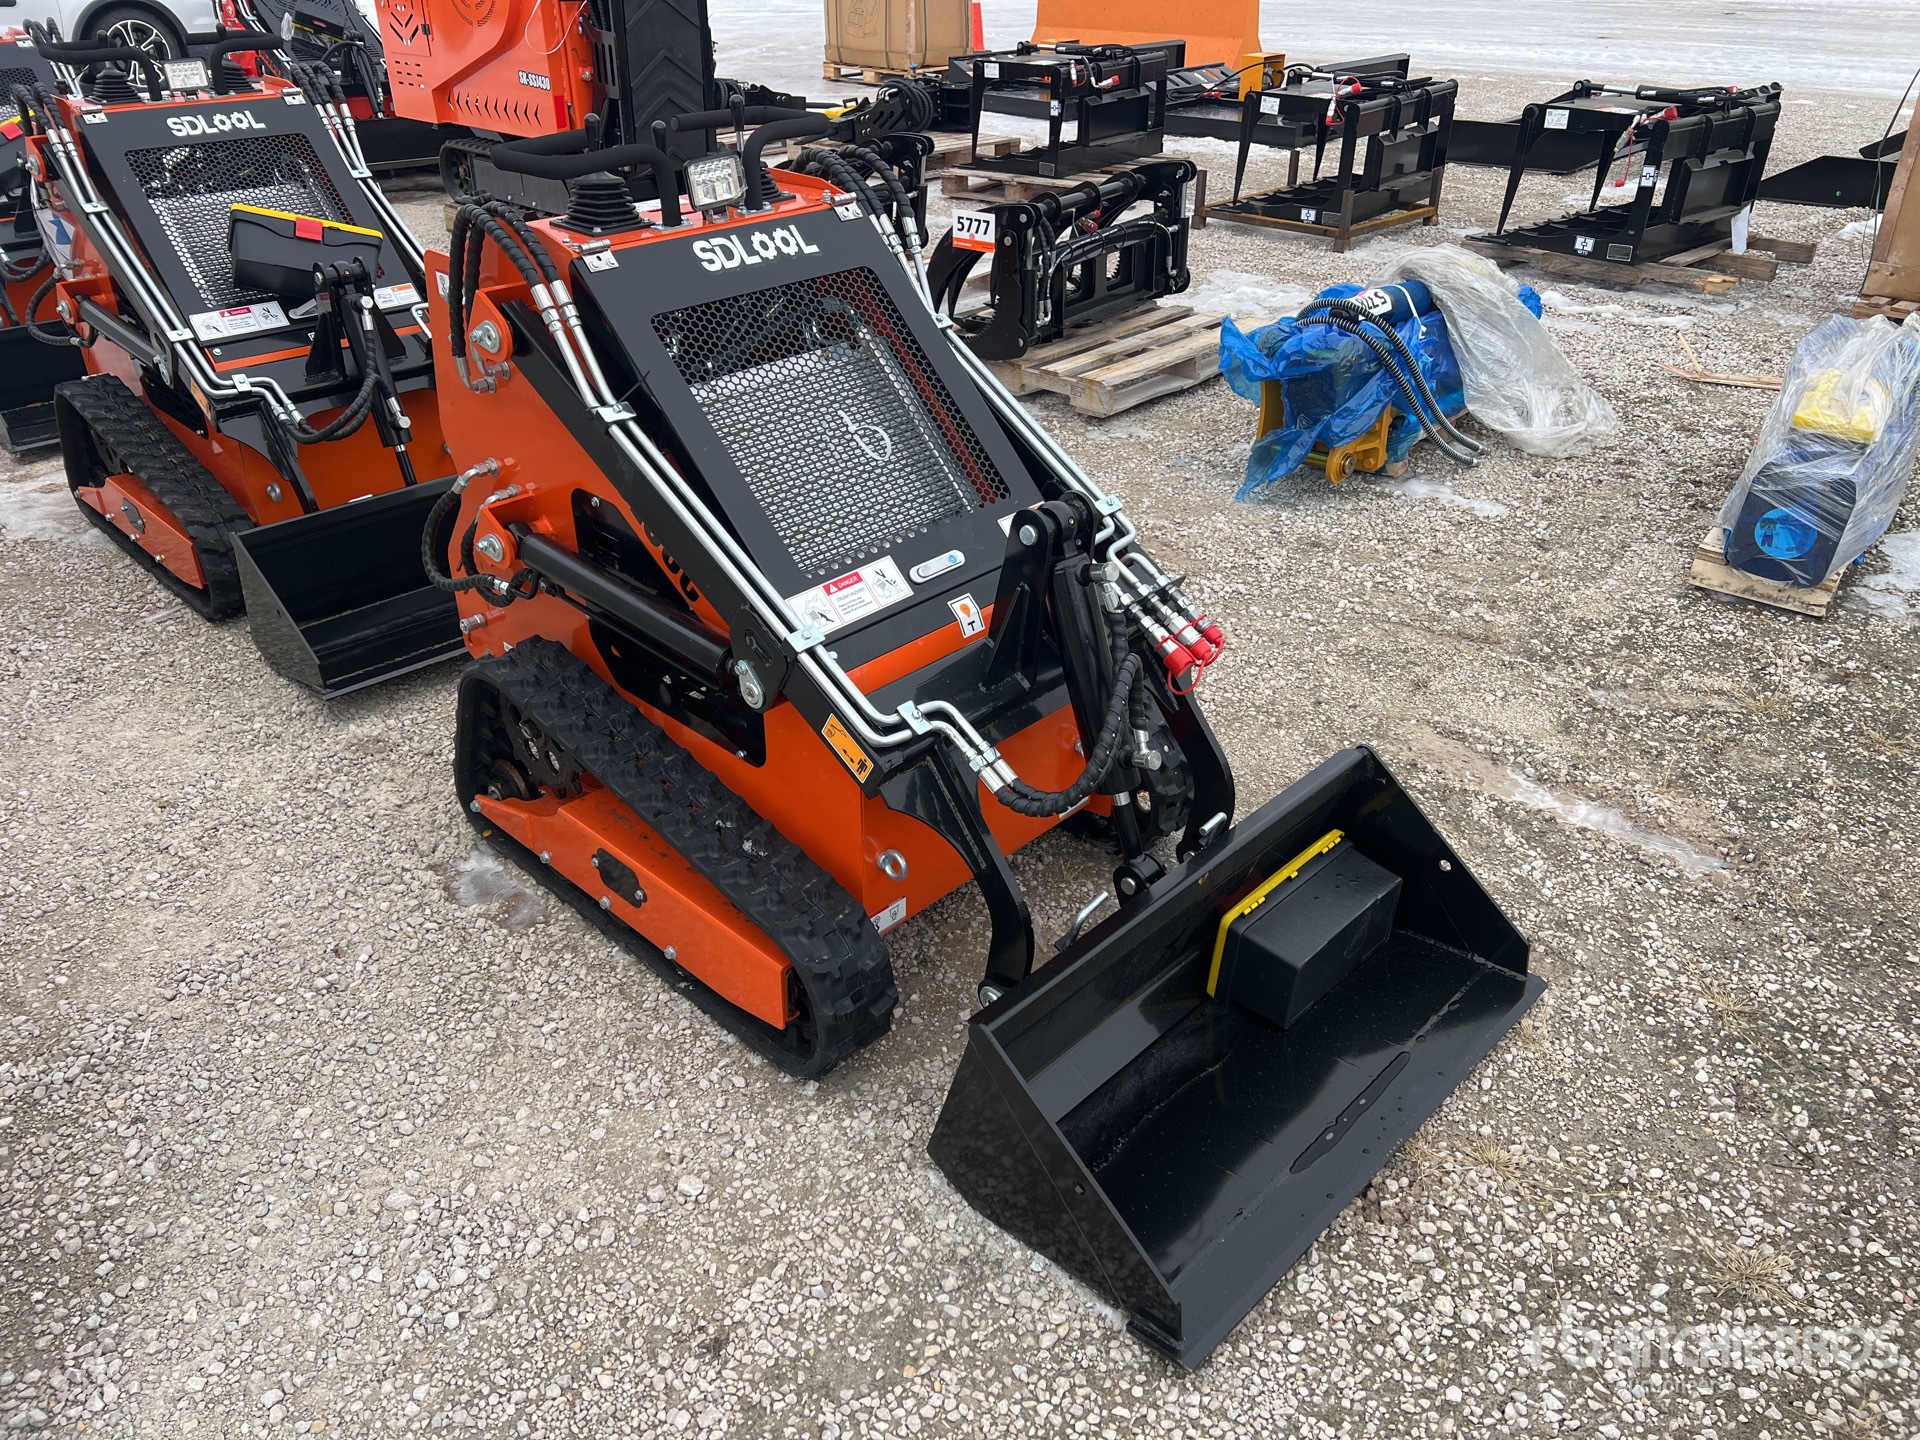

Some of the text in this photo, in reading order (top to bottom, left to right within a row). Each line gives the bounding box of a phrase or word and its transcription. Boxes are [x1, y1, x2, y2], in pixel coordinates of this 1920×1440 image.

[166, 110, 266, 136] SDLOOL
[957, 215, 990, 235] 5777
[692, 224, 820, 272] SDLOOL
[837, 576, 858, 588] DANGER
[967, 620, 976, 631] T
